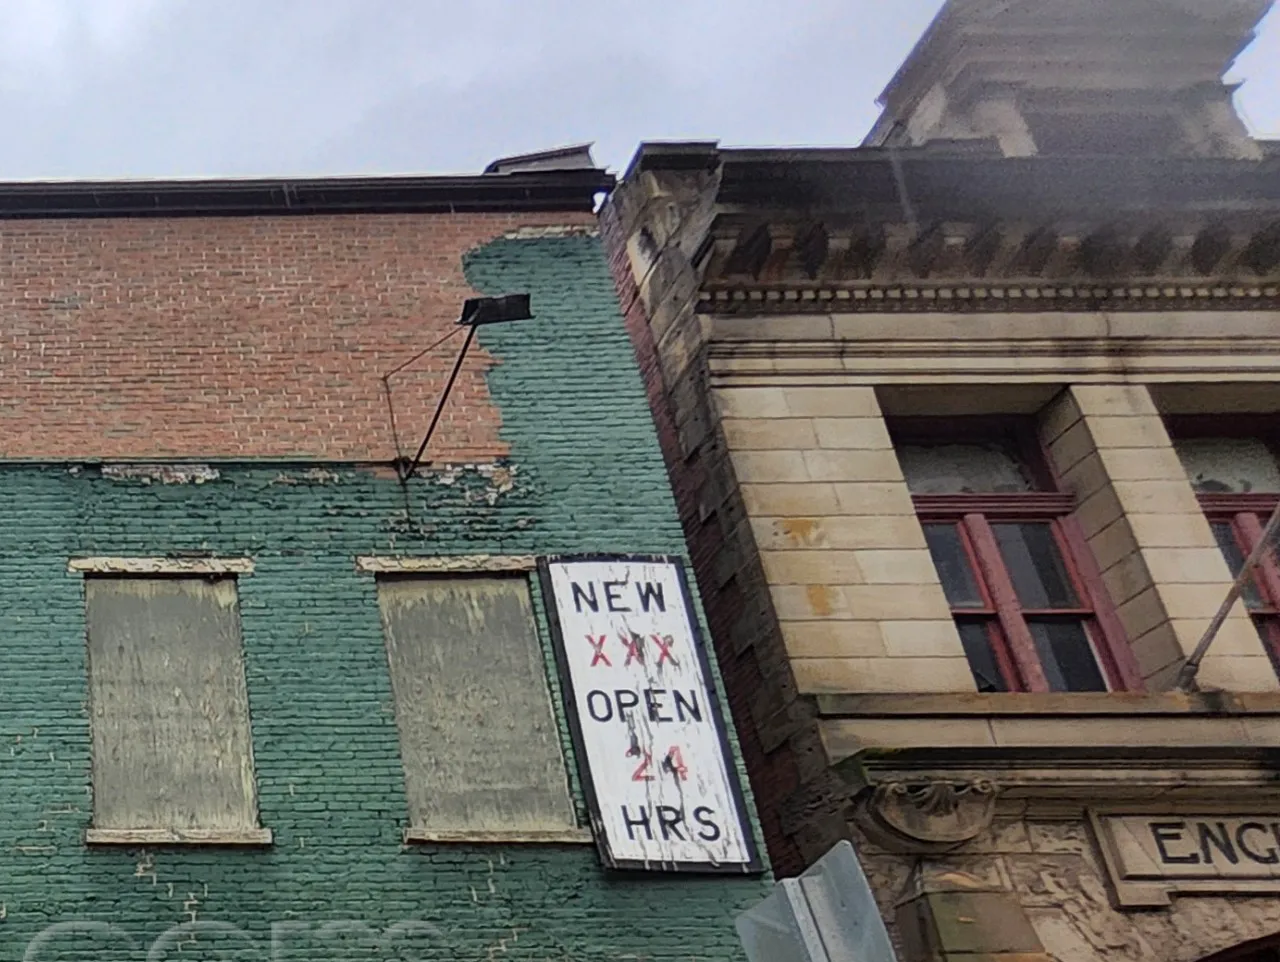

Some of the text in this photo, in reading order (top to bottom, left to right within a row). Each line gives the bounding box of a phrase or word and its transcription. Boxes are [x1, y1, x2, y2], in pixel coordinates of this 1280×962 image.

[572, 581, 666, 613] NEW
[585, 634, 678, 668] XXX
[586, 689, 703, 723] OPEN
[626, 745, 688, 781] 24
[622, 805, 721, 842] HRS
